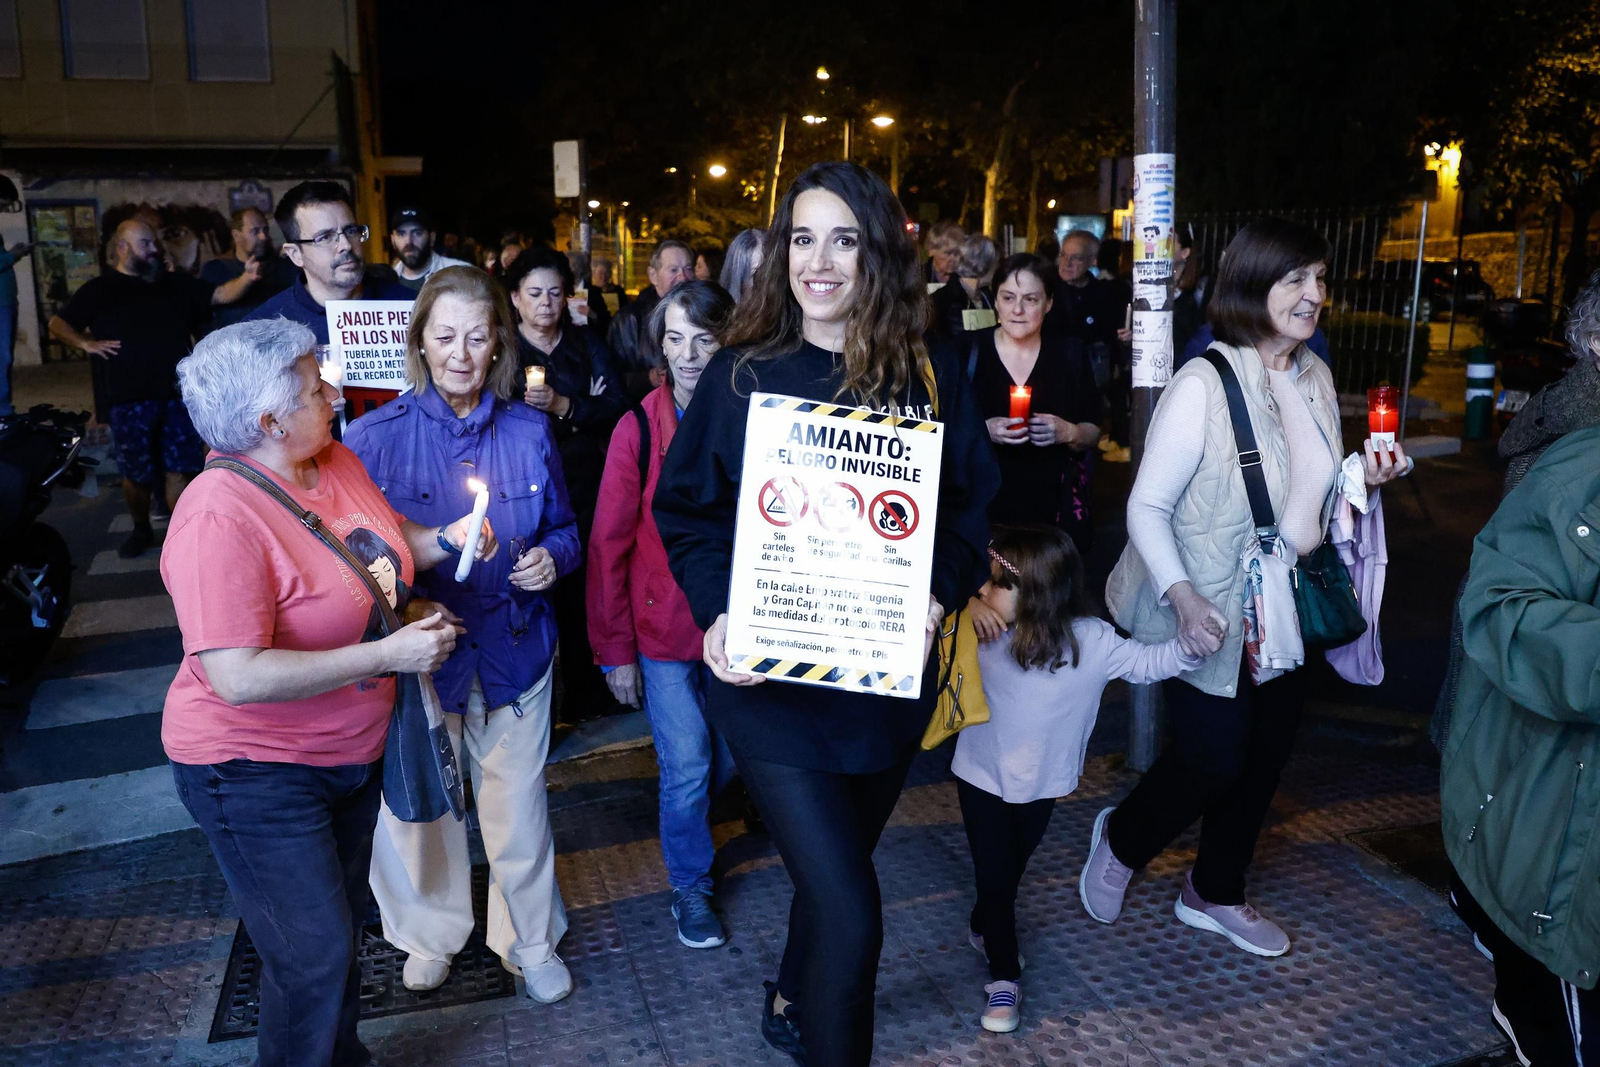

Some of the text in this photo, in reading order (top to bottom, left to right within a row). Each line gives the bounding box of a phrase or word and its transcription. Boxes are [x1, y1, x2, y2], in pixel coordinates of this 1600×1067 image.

[336, 311, 412, 329] ¿NADIE PIE
[342, 330, 360, 345] EN
[363, 330, 388, 344] LOS
[344, 348, 380, 359] TUBERÍA
[382, 350, 392, 358] DE
[346, 362, 352, 370] A
[354, 361, 375, 370] SOLO
[378, 360, 383, 369] 3
[347, 372, 362, 381] DEL
[364, 371, 395, 380] RECREO
[786, 422, 912, 462] AMIANTO:
[766, 448, 922, 484] PELIGRO INVISIBLE
[773, 532, 786, 541] Sin
[807, 535, 820, 544] Sin
[762, 543, 795, 553] carteles
[883, 544, 897, 555] Sin
[762, 553, 772, 561] de
[756, 578, 768, 590] En
[770, 580, 779, 591] la
[781, 582, 804, 594] calle
[864, 591, 903, 605] Eugenia
[763, 595, 770, 606] y
[771, 594, 794, 606] Gran
[836, 604, 849, 613] no
[851, 606, 863, 614] se
[753, 606, 766, 617] las
[768, 609, 808, 622] medidas
[828, 616, 877, 629] protocolo
[879, 620, 905, 633] RERA
[755, 636, 775, 647] Exige
[776, 639, 824, 653] señalización,
[872, 649, 889, 660] EPIs
